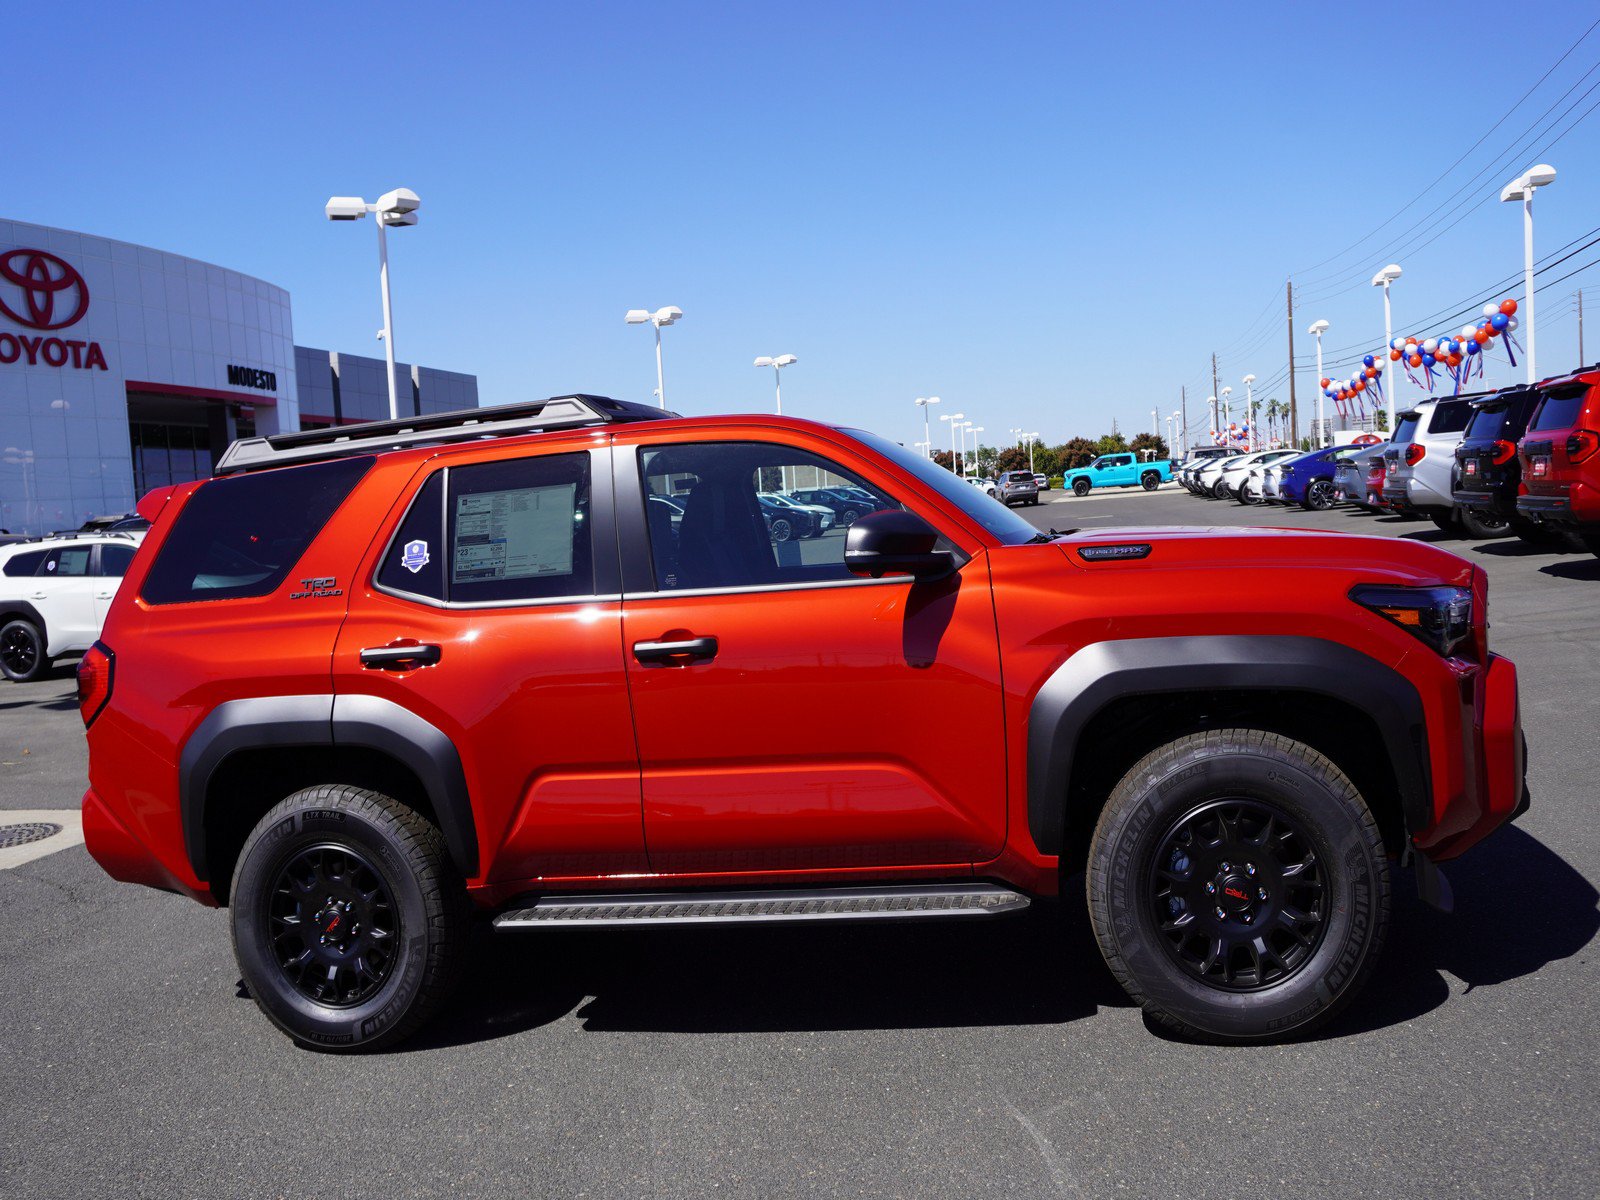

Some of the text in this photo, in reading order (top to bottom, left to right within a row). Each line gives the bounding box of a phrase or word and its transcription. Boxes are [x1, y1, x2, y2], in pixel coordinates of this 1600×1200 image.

[0, 333, 108, 371] OYOTA
[227, 364, 277, 392] MODESTO
[300, 577, 336, 591] TRD
[312, 589, 343, 598] ROAD
[321, 811, 340, 820] TRAIL
[1113, 803, 1154, 909] MICHELIN
[1225, 887, 1249, 900] TRD
[1328, 884, 1369, 991] MICHELIN
